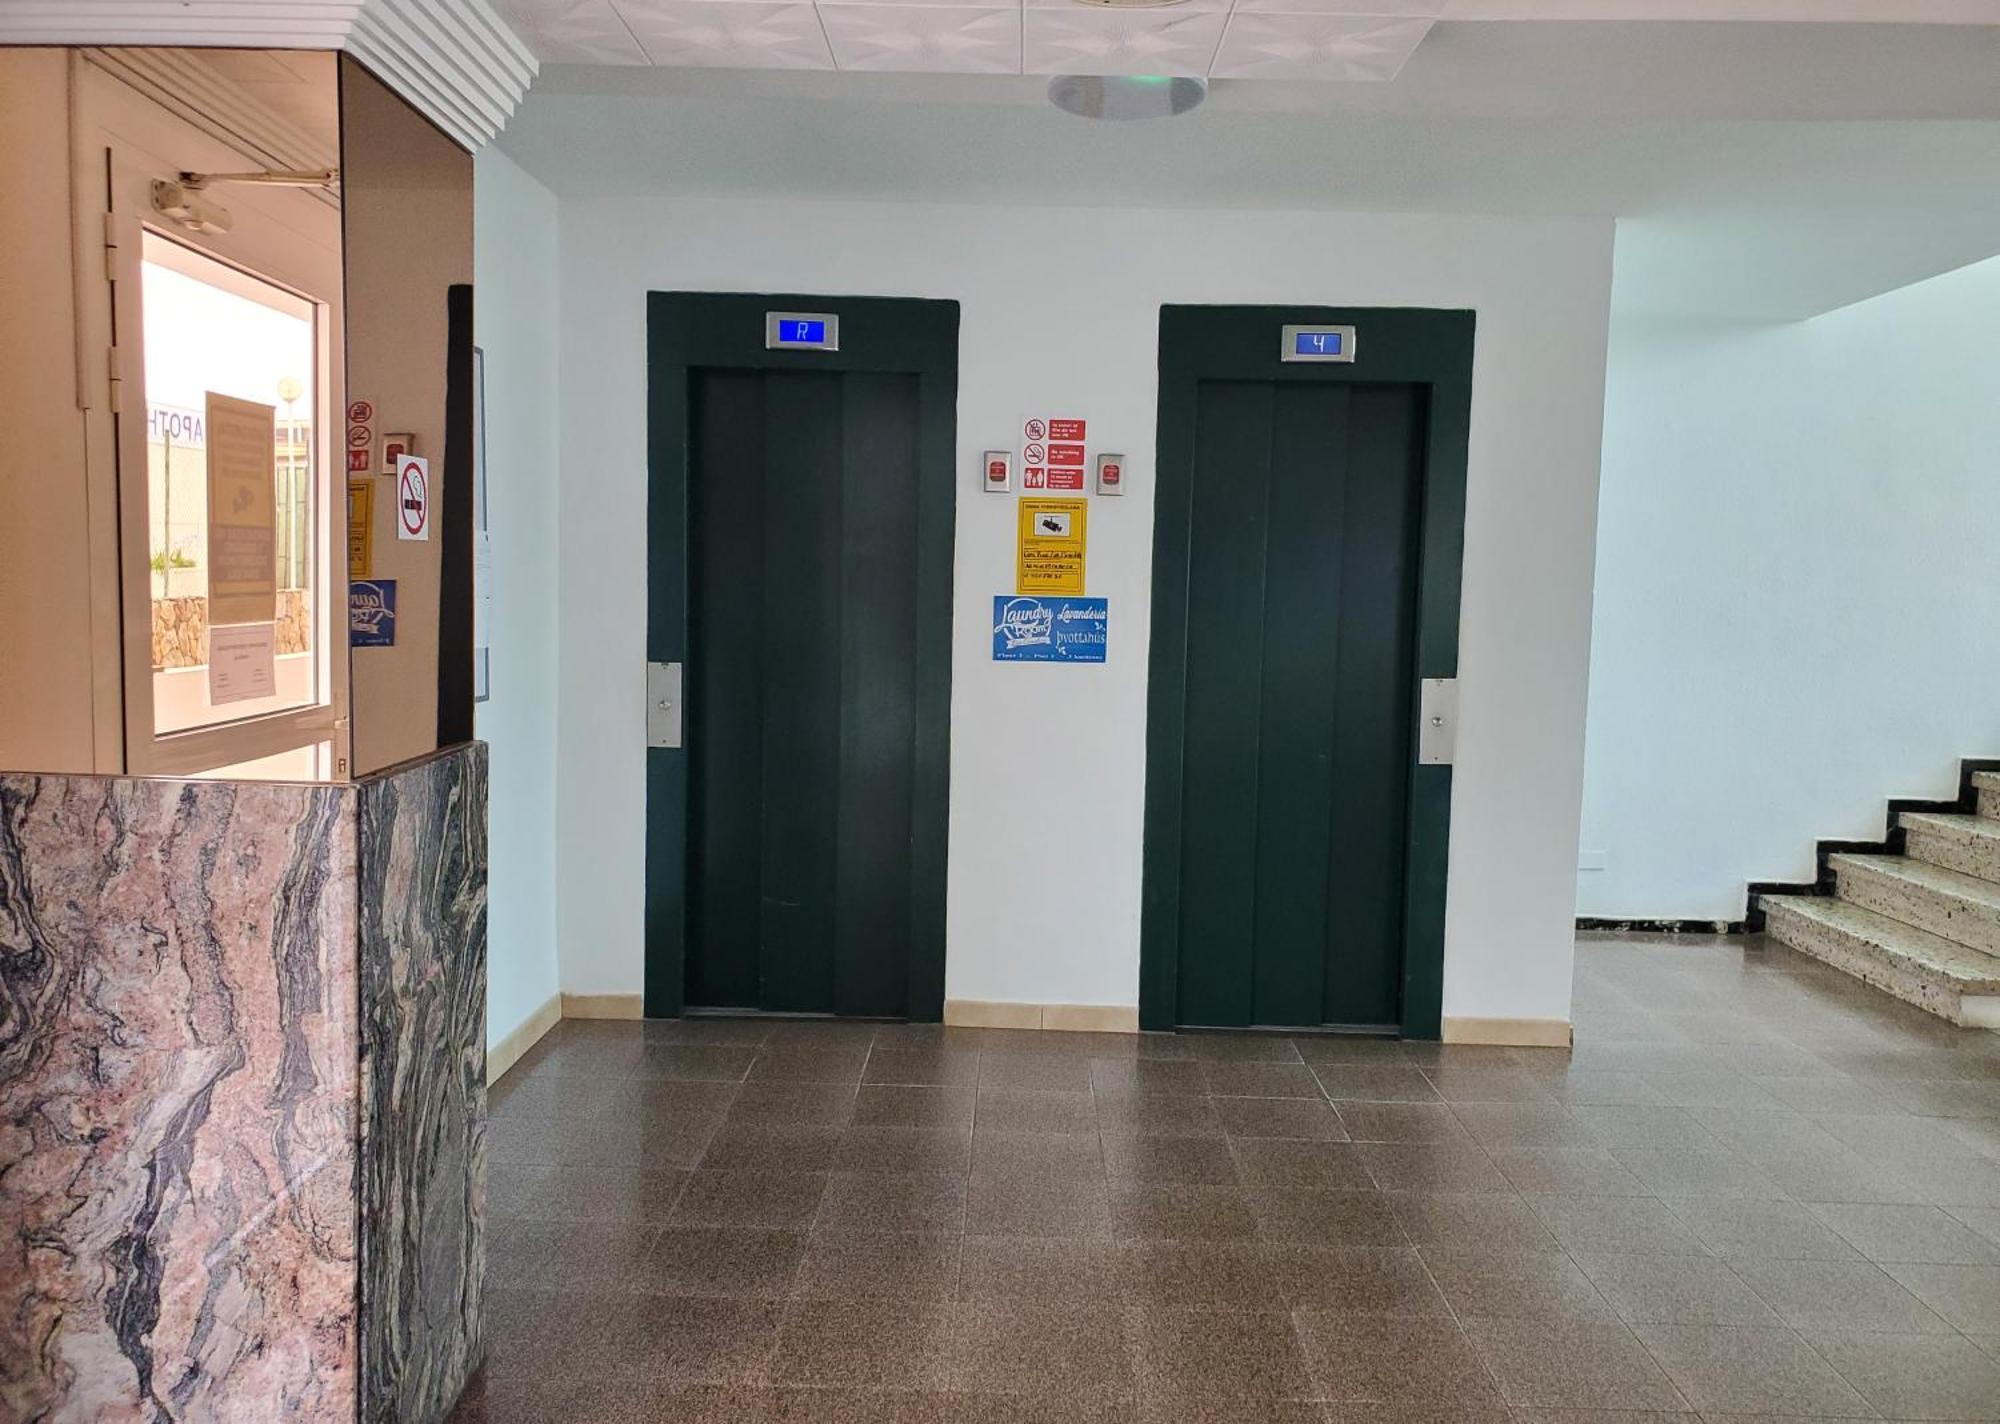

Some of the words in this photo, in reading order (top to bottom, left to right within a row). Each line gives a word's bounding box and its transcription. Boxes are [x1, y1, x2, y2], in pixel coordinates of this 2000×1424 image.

[796, 322, 809, 341] R
[1313, 336, 1325, 353] 4
[994, 602, 1053, 633] Laundry
